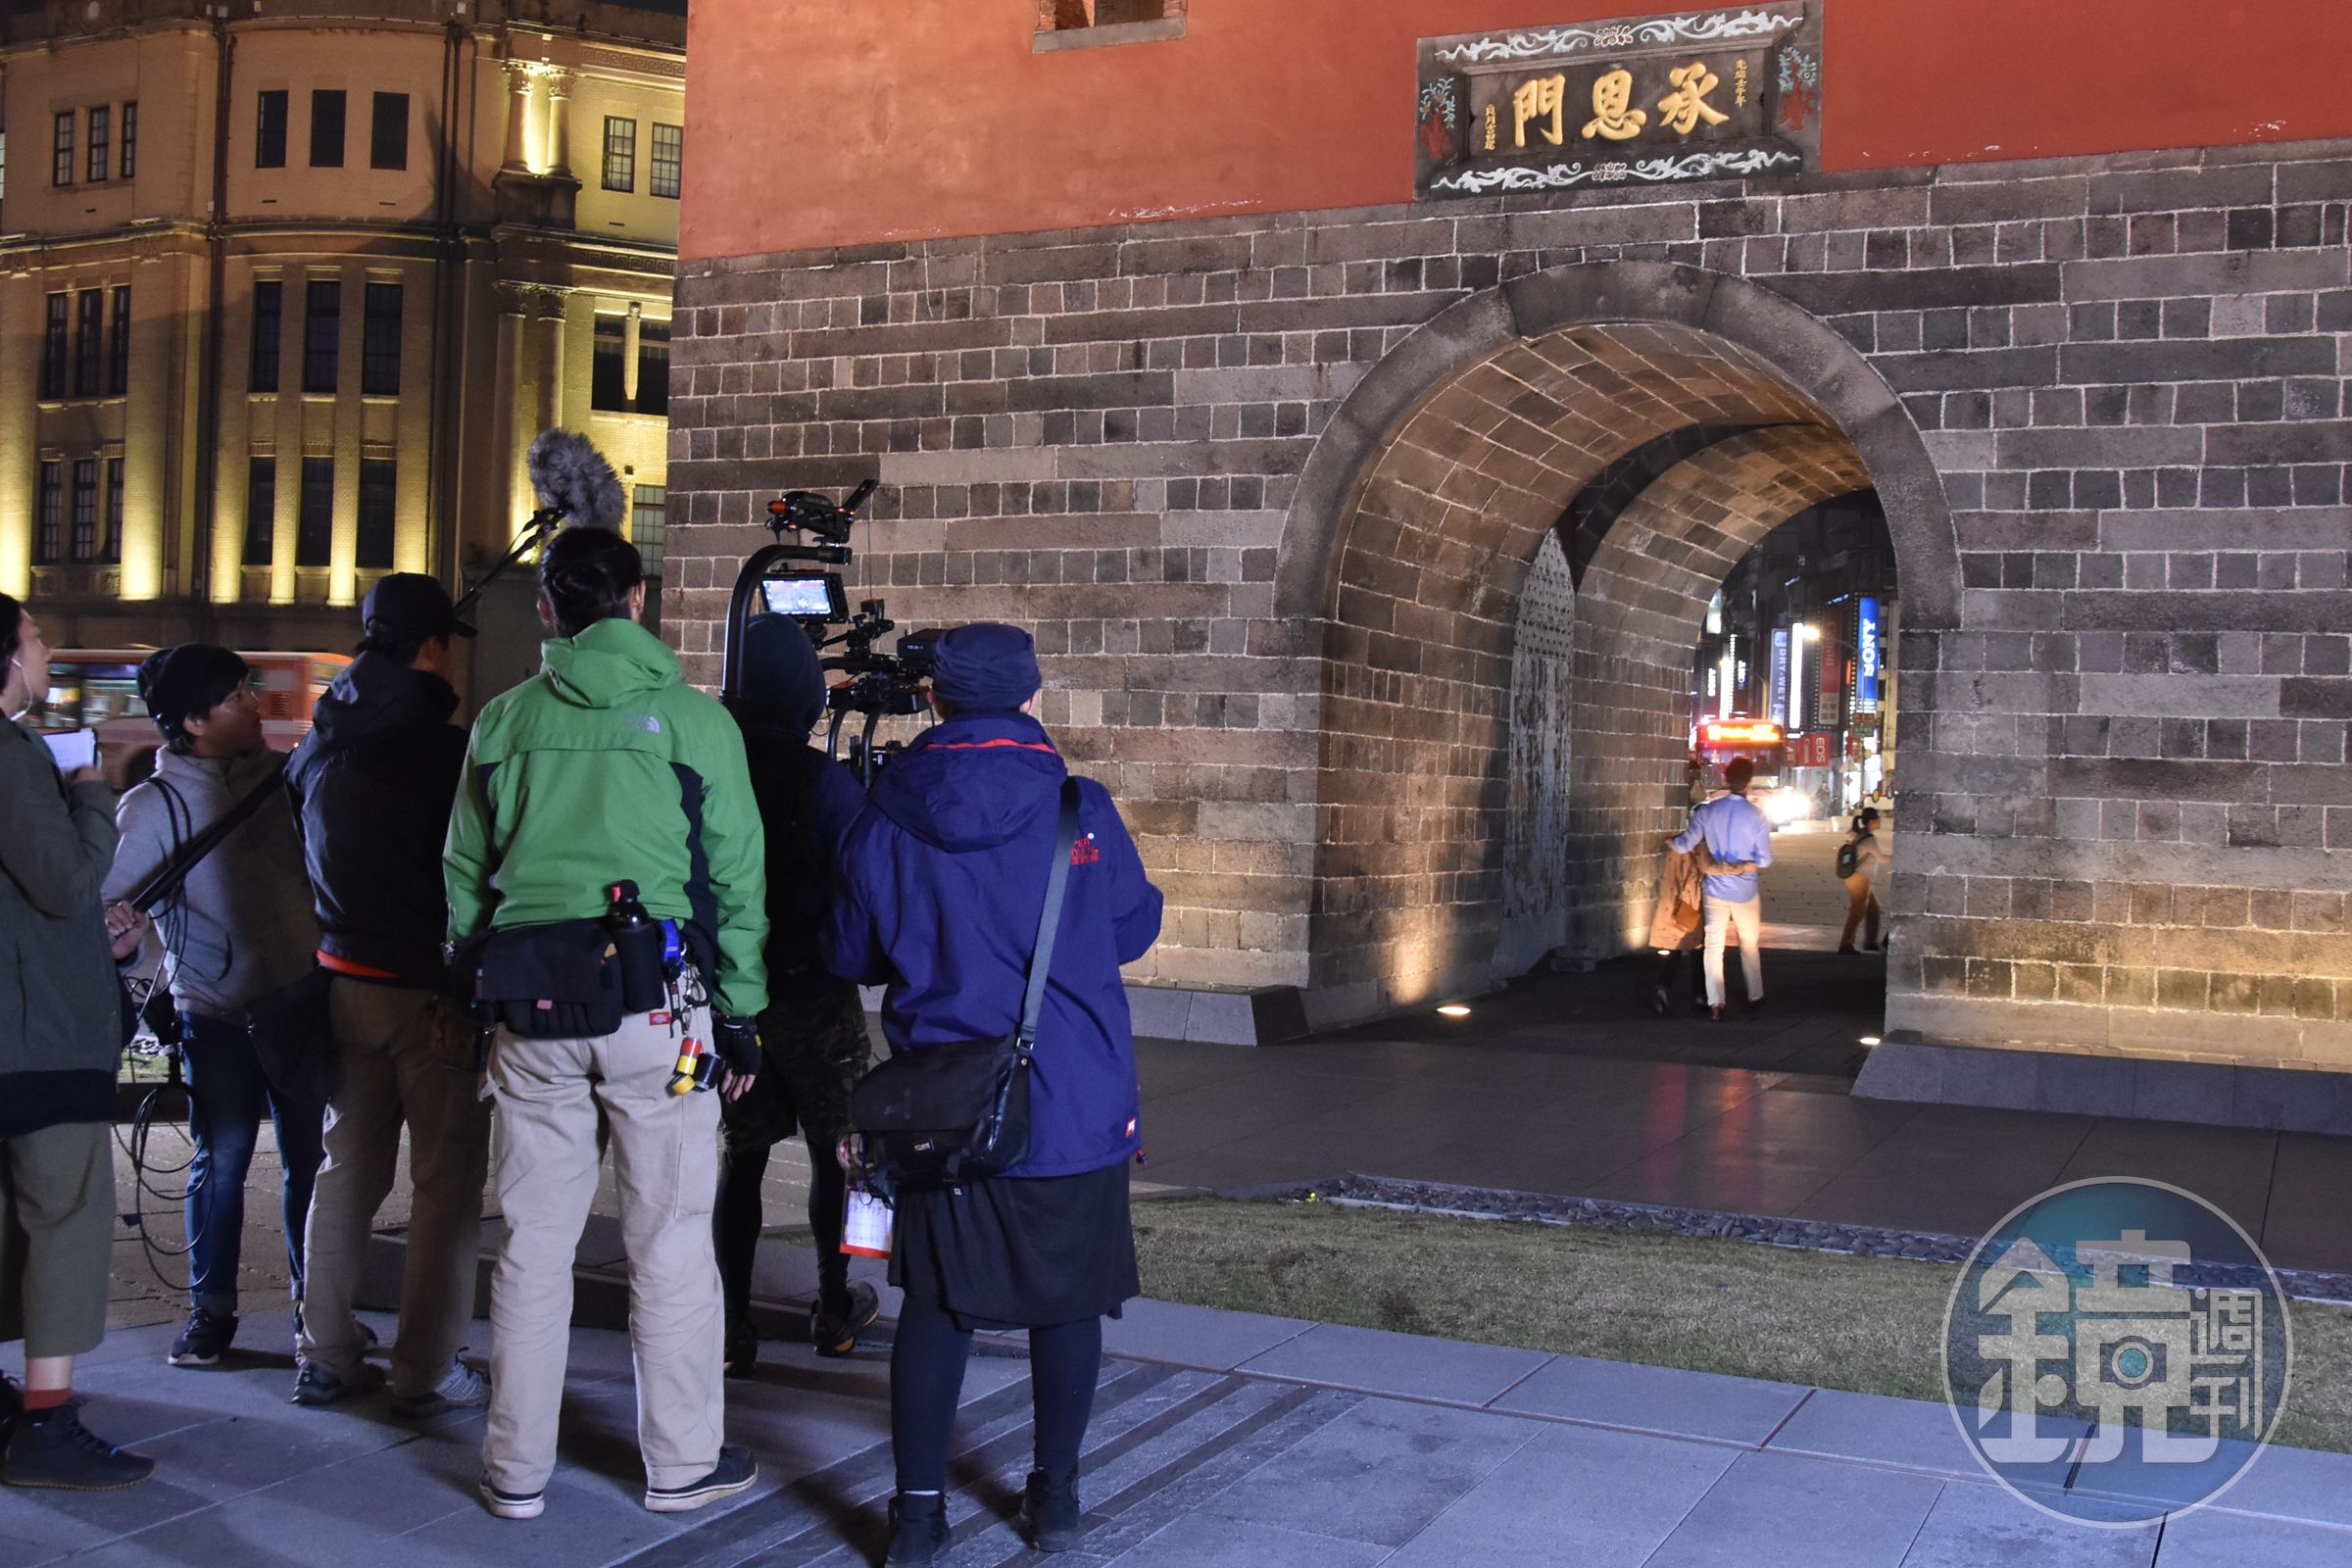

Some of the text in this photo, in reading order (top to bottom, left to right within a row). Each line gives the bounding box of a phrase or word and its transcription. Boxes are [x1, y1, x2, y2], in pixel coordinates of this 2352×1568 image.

[1513, 61, 1730, 146] 承恩門
[1861, 618, 1876, 677] SONY
[1815, 736, 1826, 763] EOS
